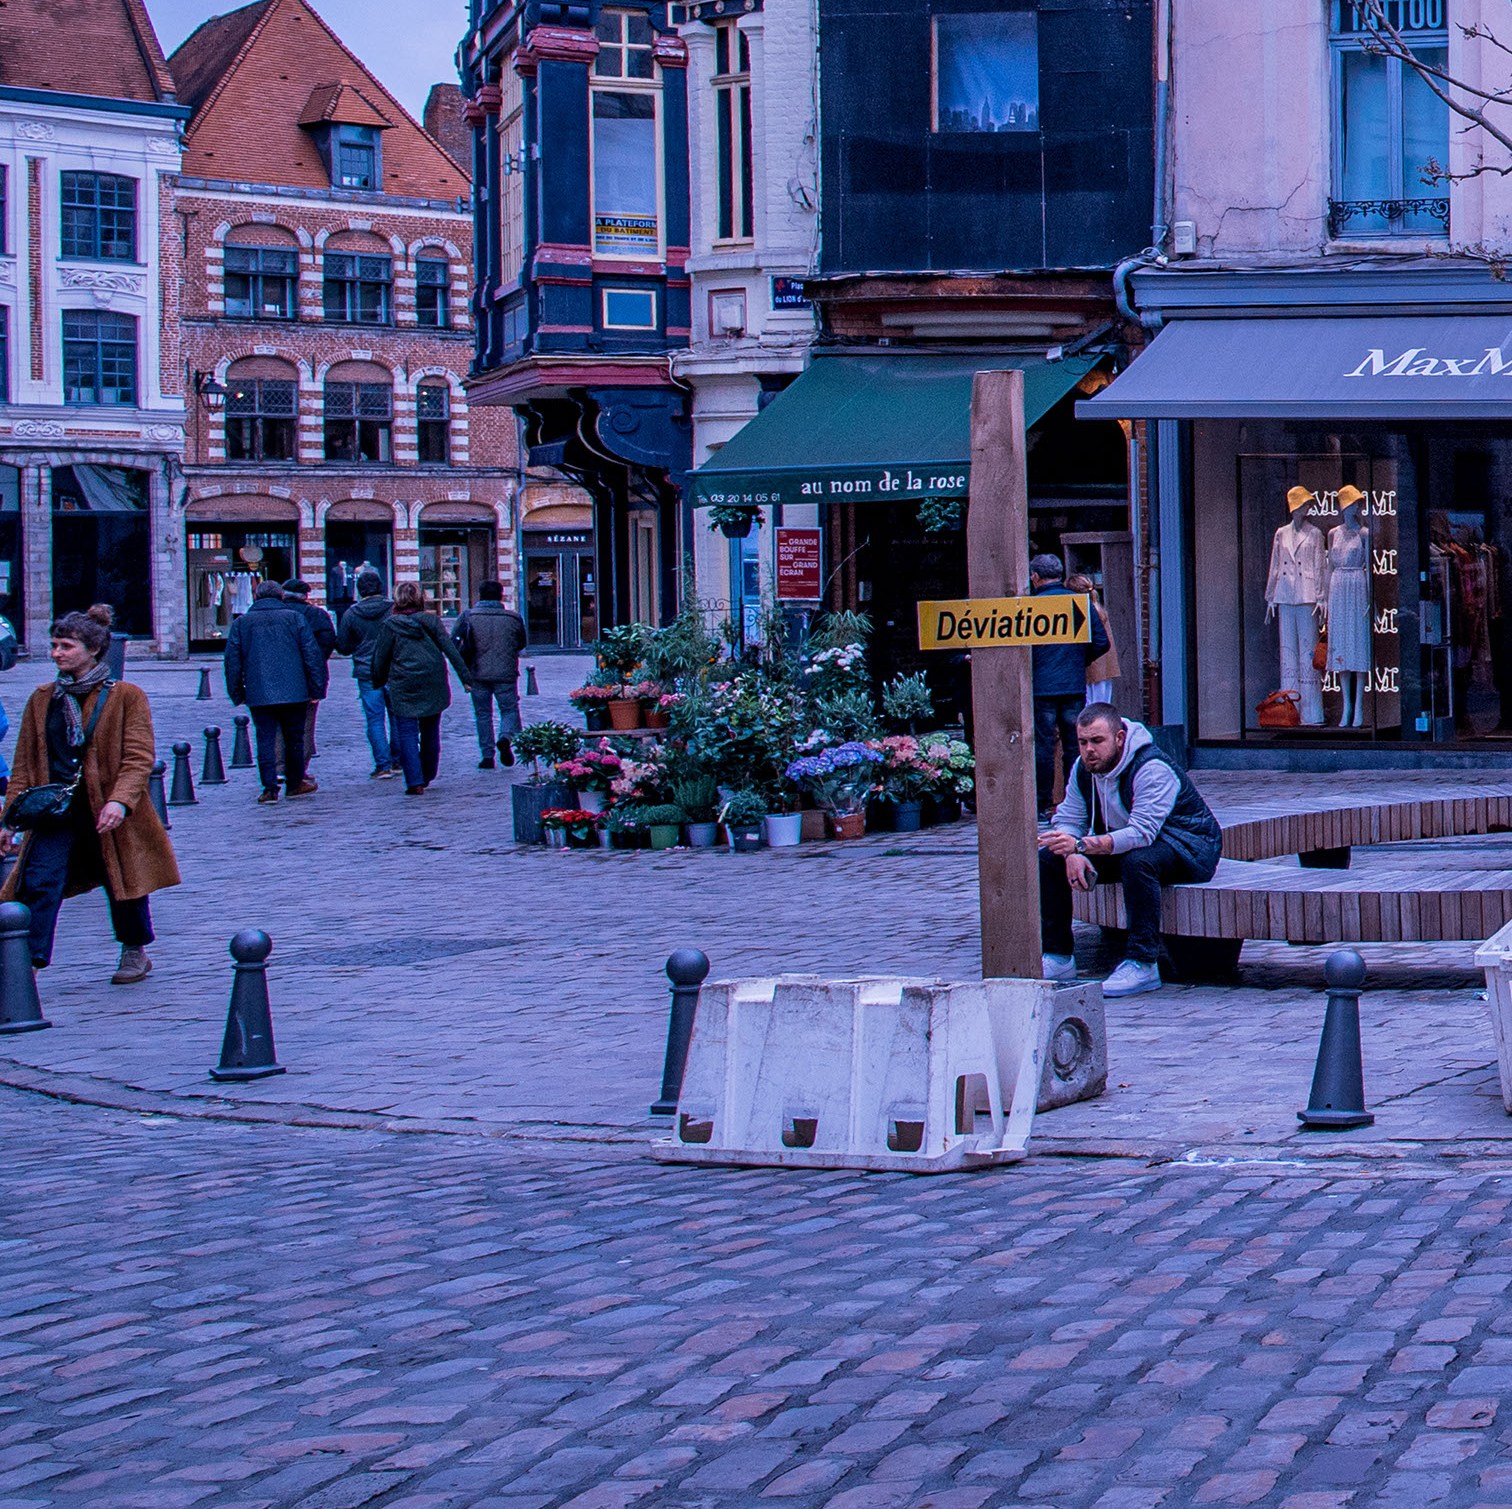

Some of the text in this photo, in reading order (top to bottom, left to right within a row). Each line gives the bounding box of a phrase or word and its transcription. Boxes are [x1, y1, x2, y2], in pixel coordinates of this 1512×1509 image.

[801, 471, 966, 495] au nom de la rose
[710, 493, 725, 503] 03
[727, 494, 740, 503] 20
[743, 493, 753, 503] 14
[755, 492, 769, 502] 05
[771, 492, 781, 502] 61
[789, 538, 818, 546] GRANDE
[936, 607, 1069, 641] Déviation
